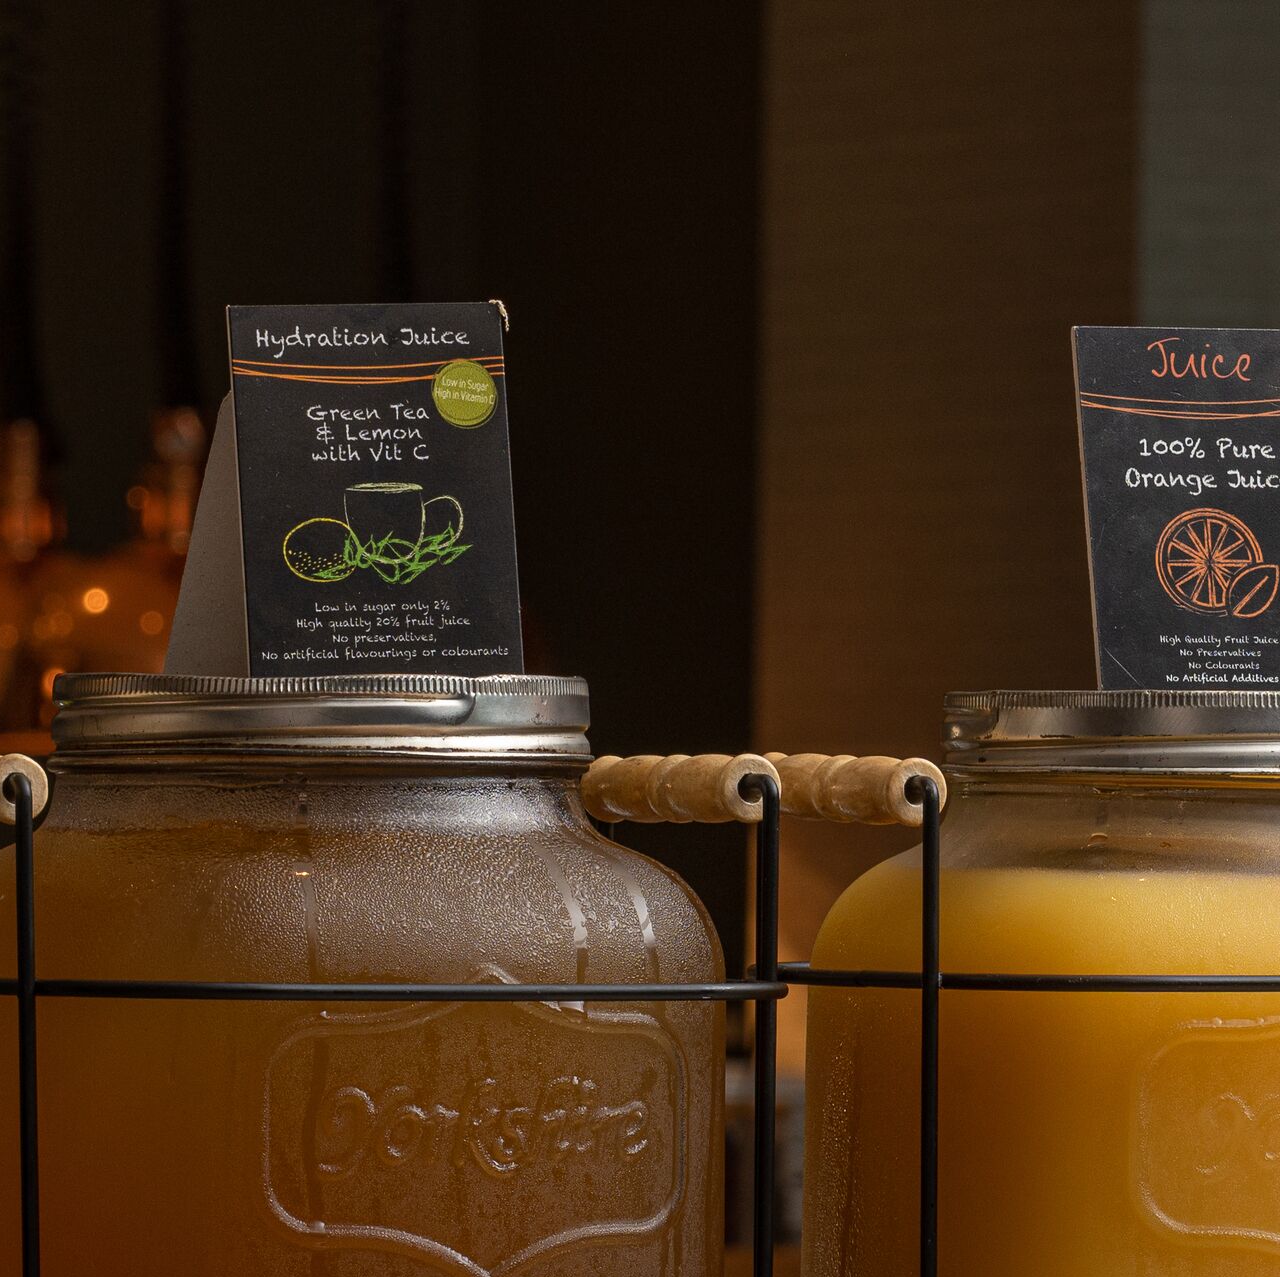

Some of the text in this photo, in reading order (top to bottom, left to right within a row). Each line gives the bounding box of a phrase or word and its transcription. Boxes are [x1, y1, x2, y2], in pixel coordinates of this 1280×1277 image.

[256, 326, 470, 358] Hydration Juice
[1147, 337, 1252, 381] Juice
[441, 375, 489, 392] Low in Sugar
[435, 387, 496, 405] High in Vitamin C
[307, 403, 430, 421] Green Tea
[316, 423, 424, 444] & Lemon
[312, 443, 430, 462] with Vit C
[1139, 437, 1277, 460] 100% Pure
[1124, 466, 1218, 496] Orange
[315, 600, 450, 616] Low in sugar only 2%
[296, 614, 471, 633] High quality 20% fruit juice
[332, 631, 437, 647] No preservatives,
[1159, 635, 1280, 648] High Quality Fruit Juice
[262, 646, 509, 663] No artificial flavourings or colourants
[1179, 647, 1262, 657] No Preservatives
[1188, 660, 1260, 670] No Colourants
[1165, 672, 1280, 684] No Artificial Additives
